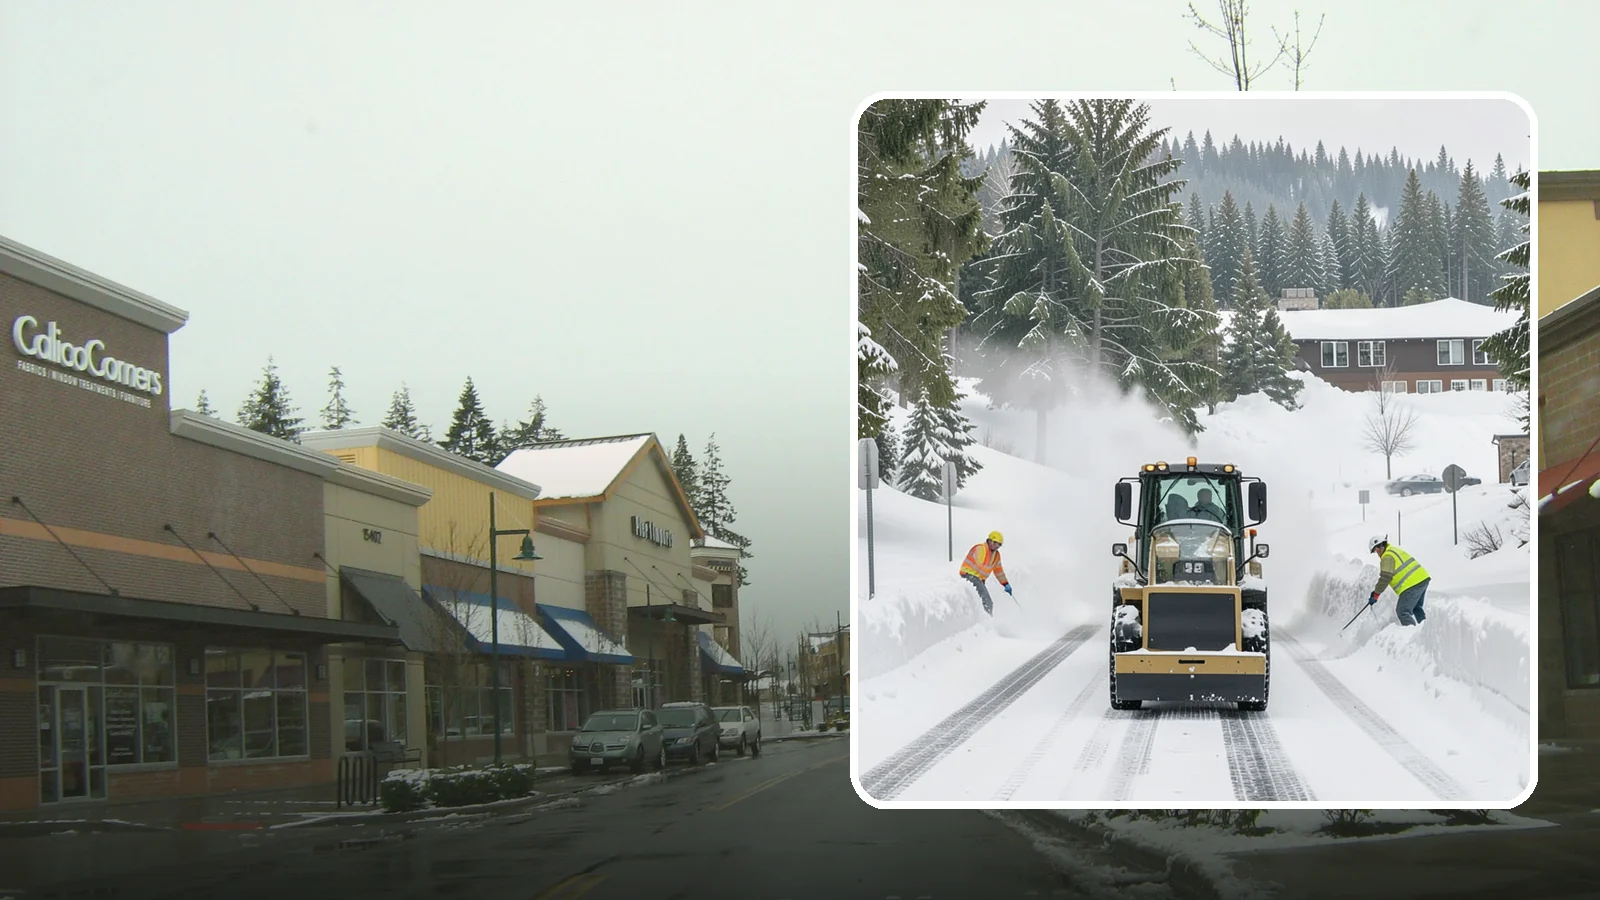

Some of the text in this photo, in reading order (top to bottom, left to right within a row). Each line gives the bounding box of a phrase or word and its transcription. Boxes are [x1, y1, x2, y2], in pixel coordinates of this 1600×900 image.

[13, 315, 162, 396] CalicoCorners
[17, 360, 47, 378] FABRICS
[51, 369, 78, 387] WINDOW
[78, 378, 116, 399] TREATMENTS
